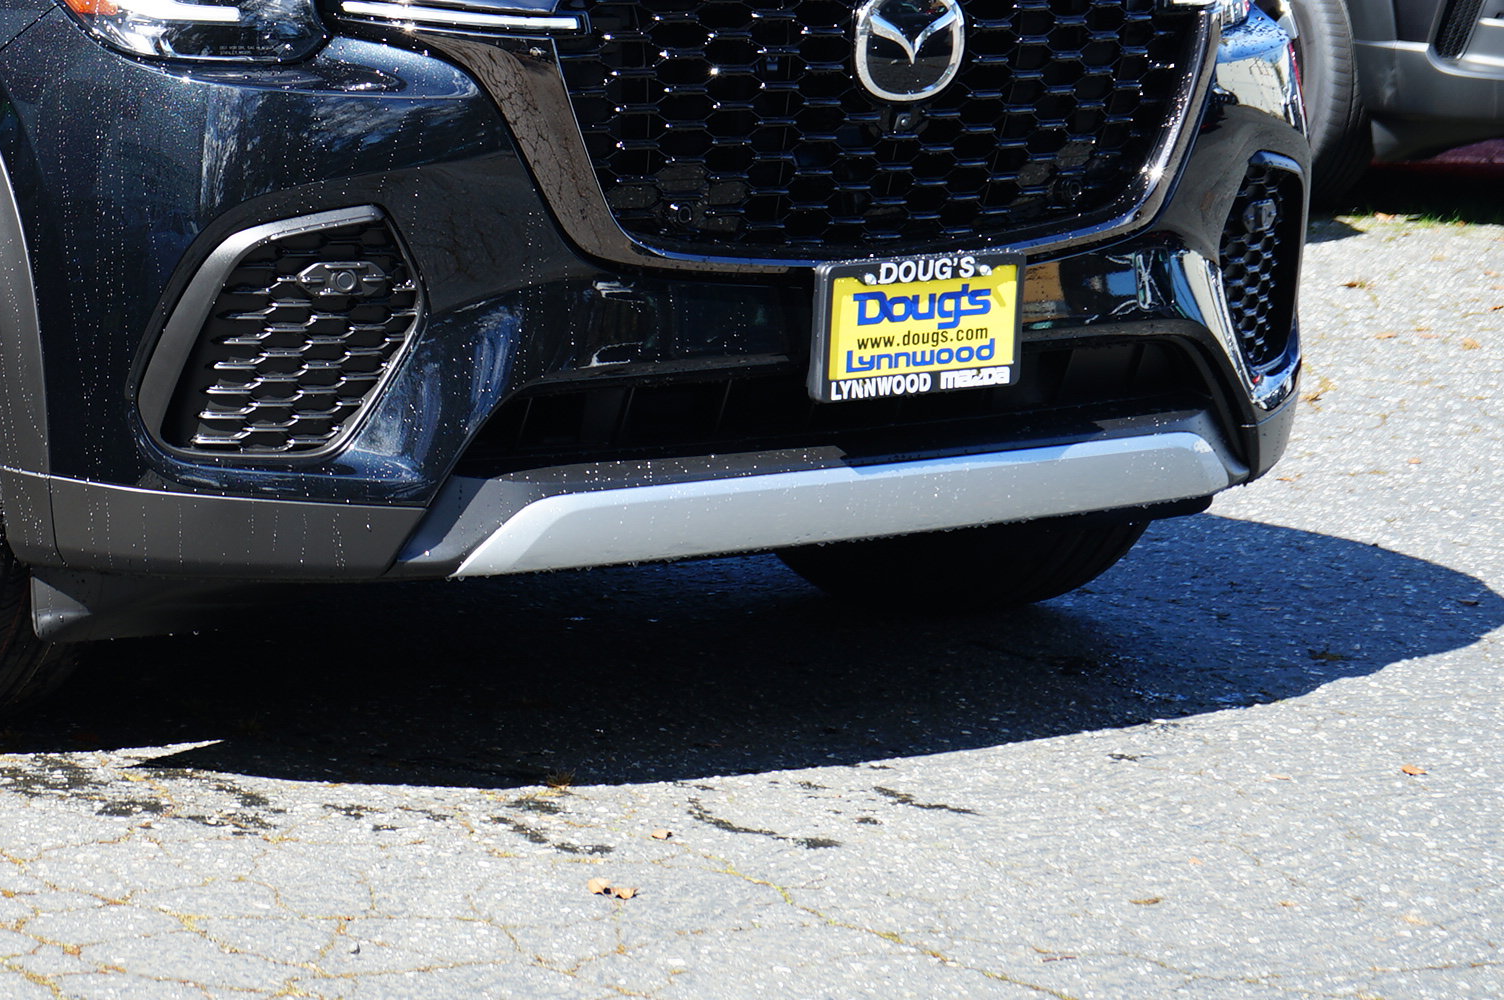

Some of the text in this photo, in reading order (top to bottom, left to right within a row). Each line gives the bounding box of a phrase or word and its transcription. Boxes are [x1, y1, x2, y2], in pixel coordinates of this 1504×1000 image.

[878, 255, 976, 285] DOUG'S
[853, 283, 992, 330] Doug's
[857, 327, 989, 350] www.dougs.com
[845, 338, 996, 373] Lynnwood
[830, 372, 932, 401] LYNNWOOD
